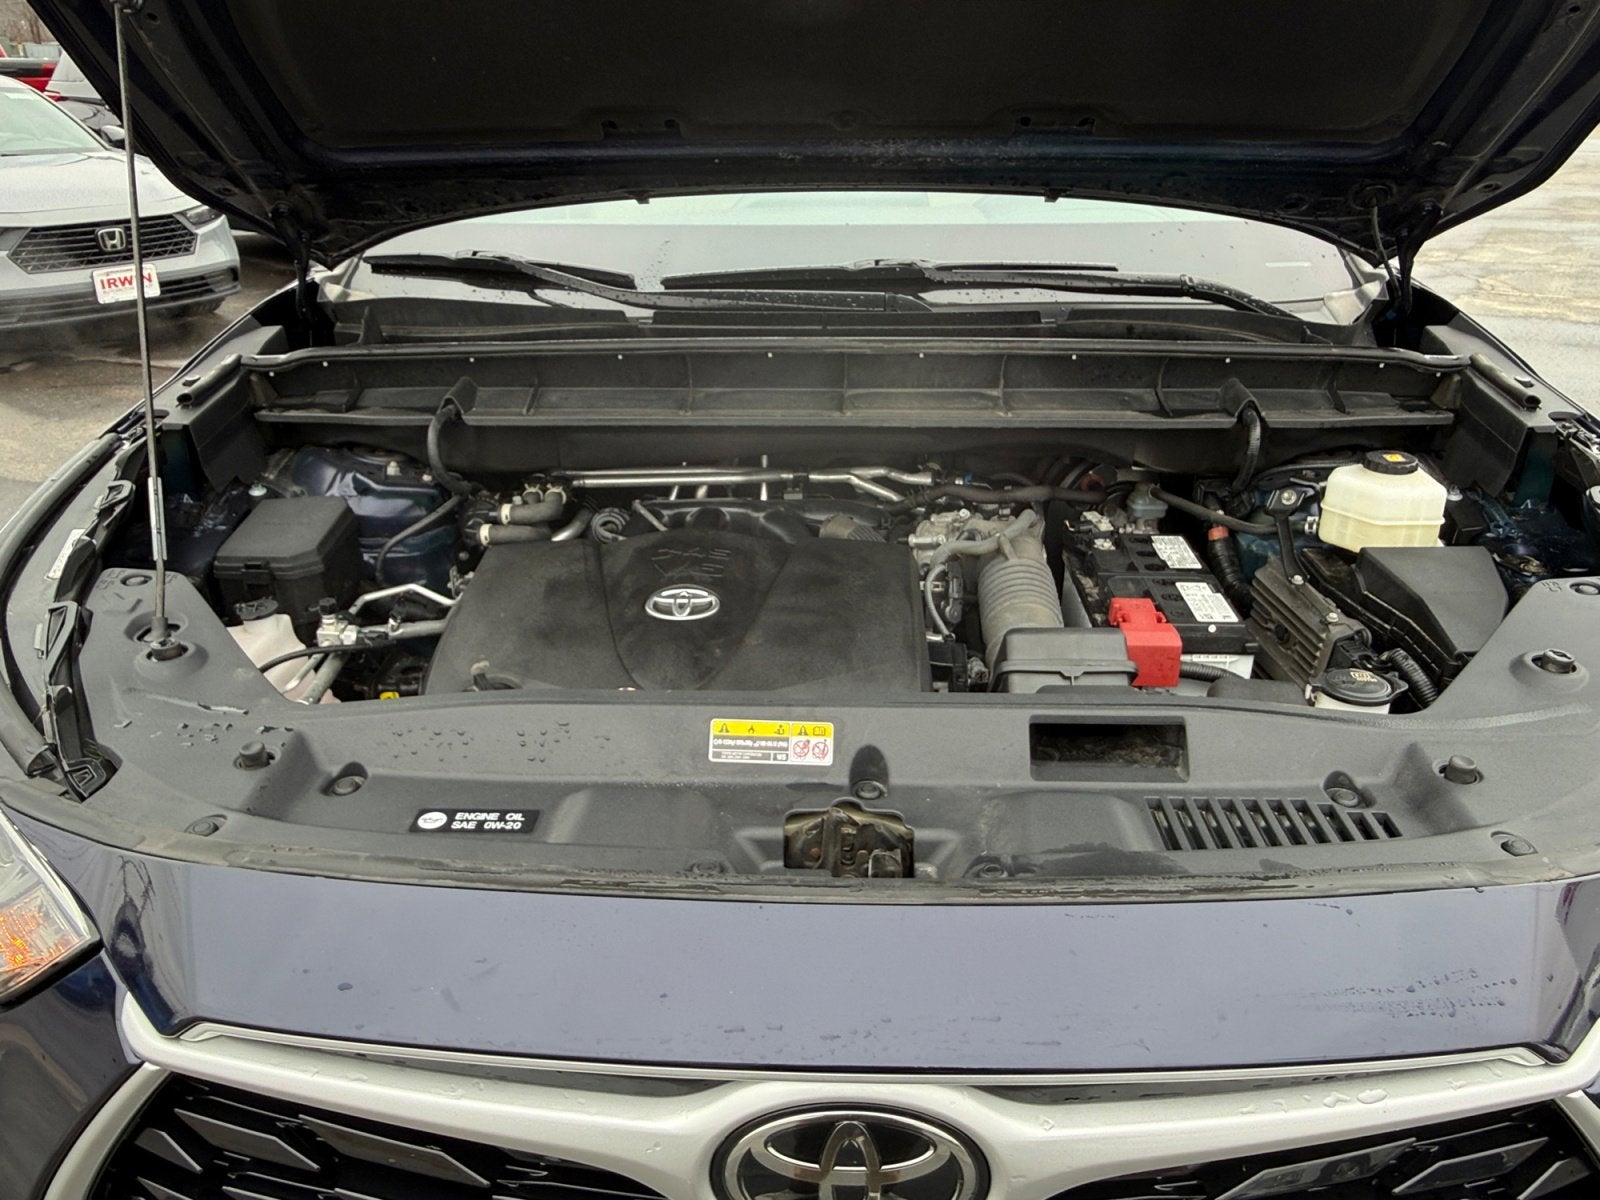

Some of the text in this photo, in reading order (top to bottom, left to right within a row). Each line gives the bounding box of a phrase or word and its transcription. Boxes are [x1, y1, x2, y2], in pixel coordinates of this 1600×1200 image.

[100, 273, 153, 290] IRWN
[454, 812, 526, 821] ENGINE OIL
[450, 821, 522, 830] SAE 0W-20
